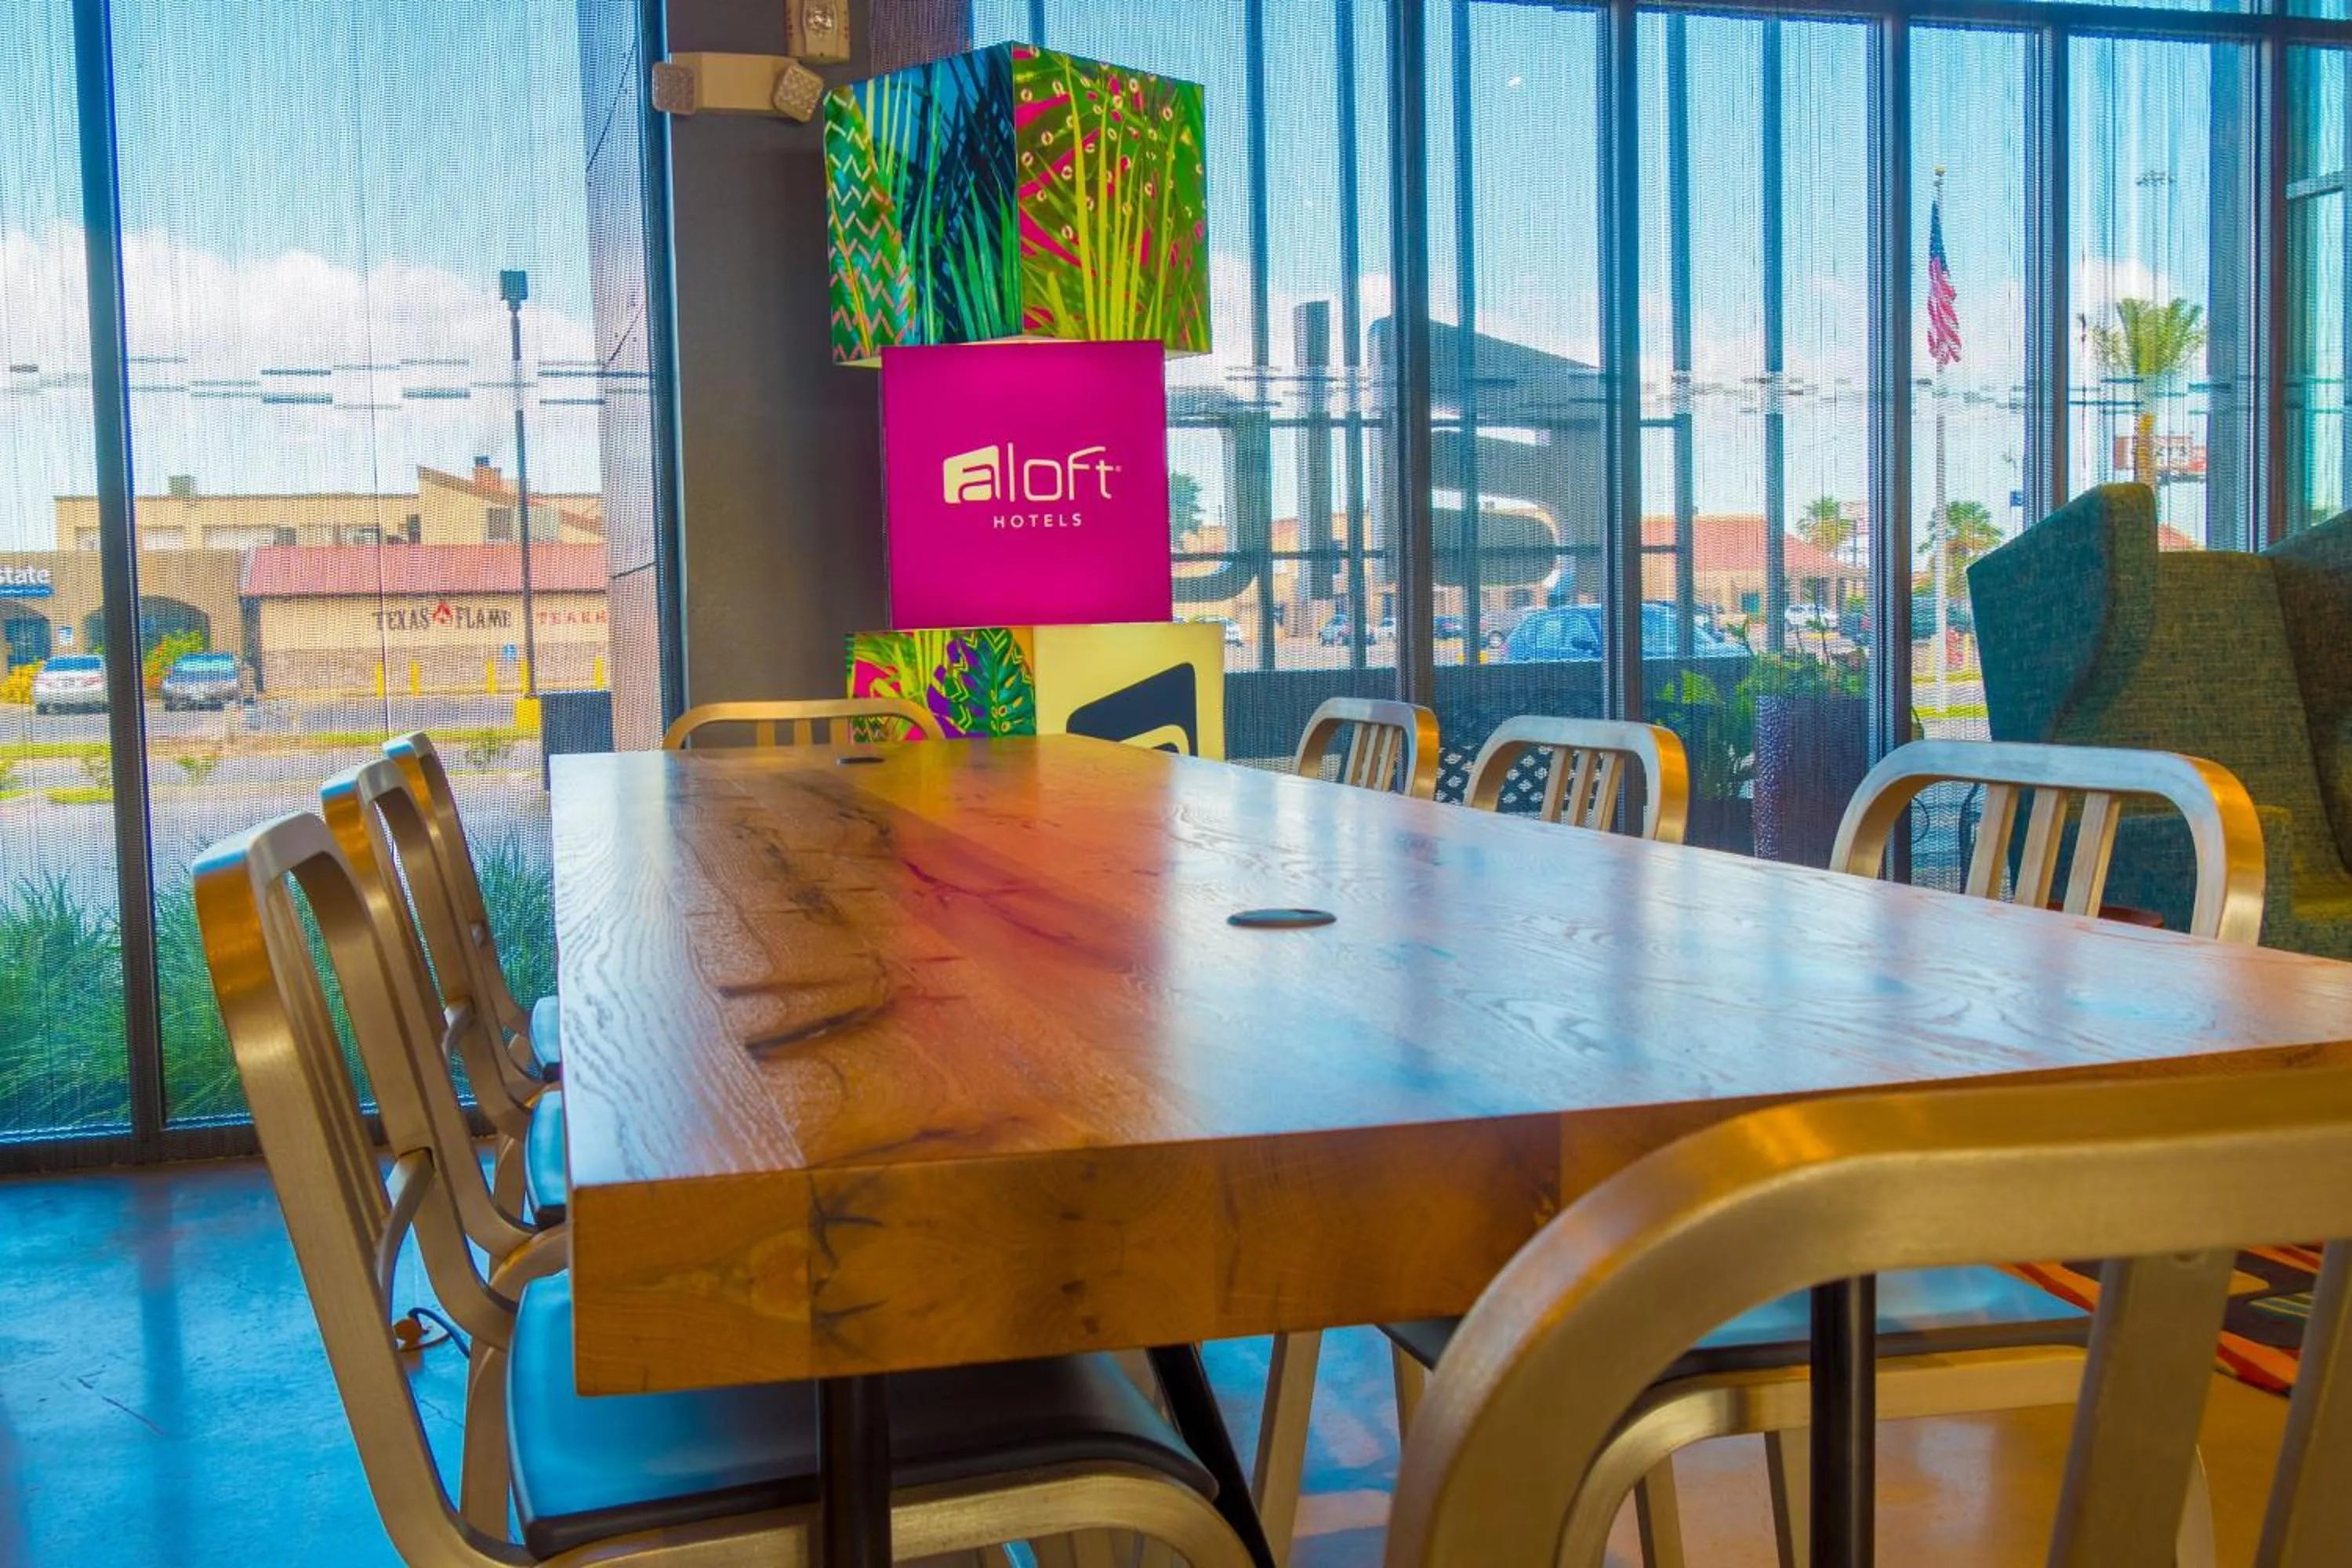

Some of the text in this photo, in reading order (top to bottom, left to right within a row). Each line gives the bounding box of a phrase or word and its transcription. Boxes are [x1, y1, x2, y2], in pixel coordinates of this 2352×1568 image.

[943, 442, 1113, 504] aloft
[993, 512, 1083, 529] HOTELS
[372, 607, 430, 631] TEXAS
[456, 605, 512, 629] FLAME
